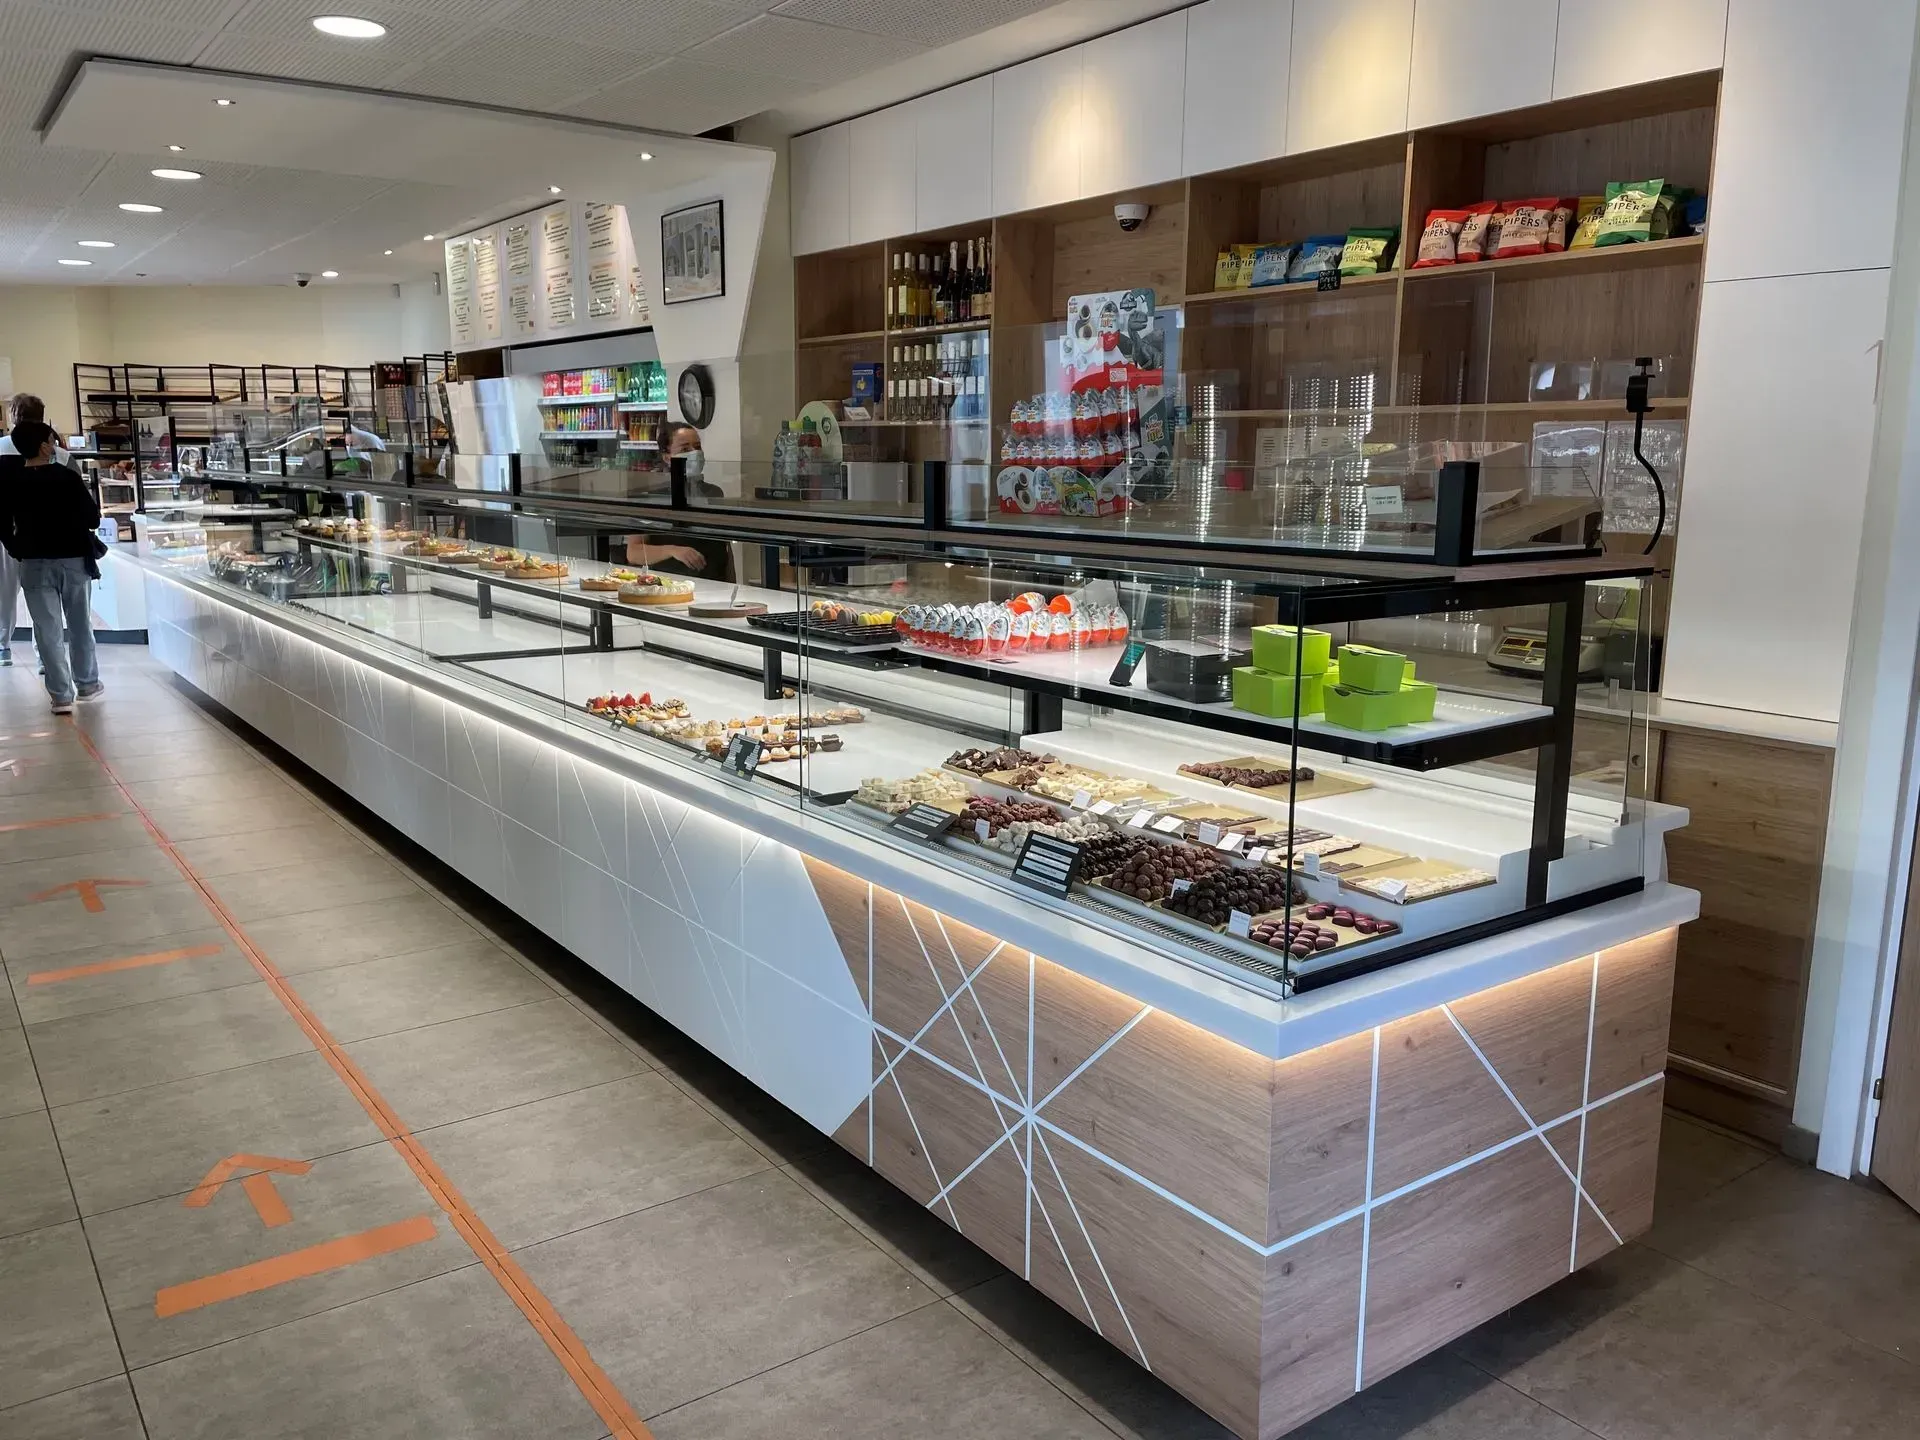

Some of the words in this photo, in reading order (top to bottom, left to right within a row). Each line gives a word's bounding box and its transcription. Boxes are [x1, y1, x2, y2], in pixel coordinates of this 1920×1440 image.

[1606, 202, 1647, 212] PIPERS
[1504, 216, 1540, 228] PIPERS
[1581, 215, 1605, 224] PIPE
[1463, 223, 1479, 232] ERS
[1423, 228, 1451, 238] PIPERS
[1221, 261, 1240, 269] PIPE
